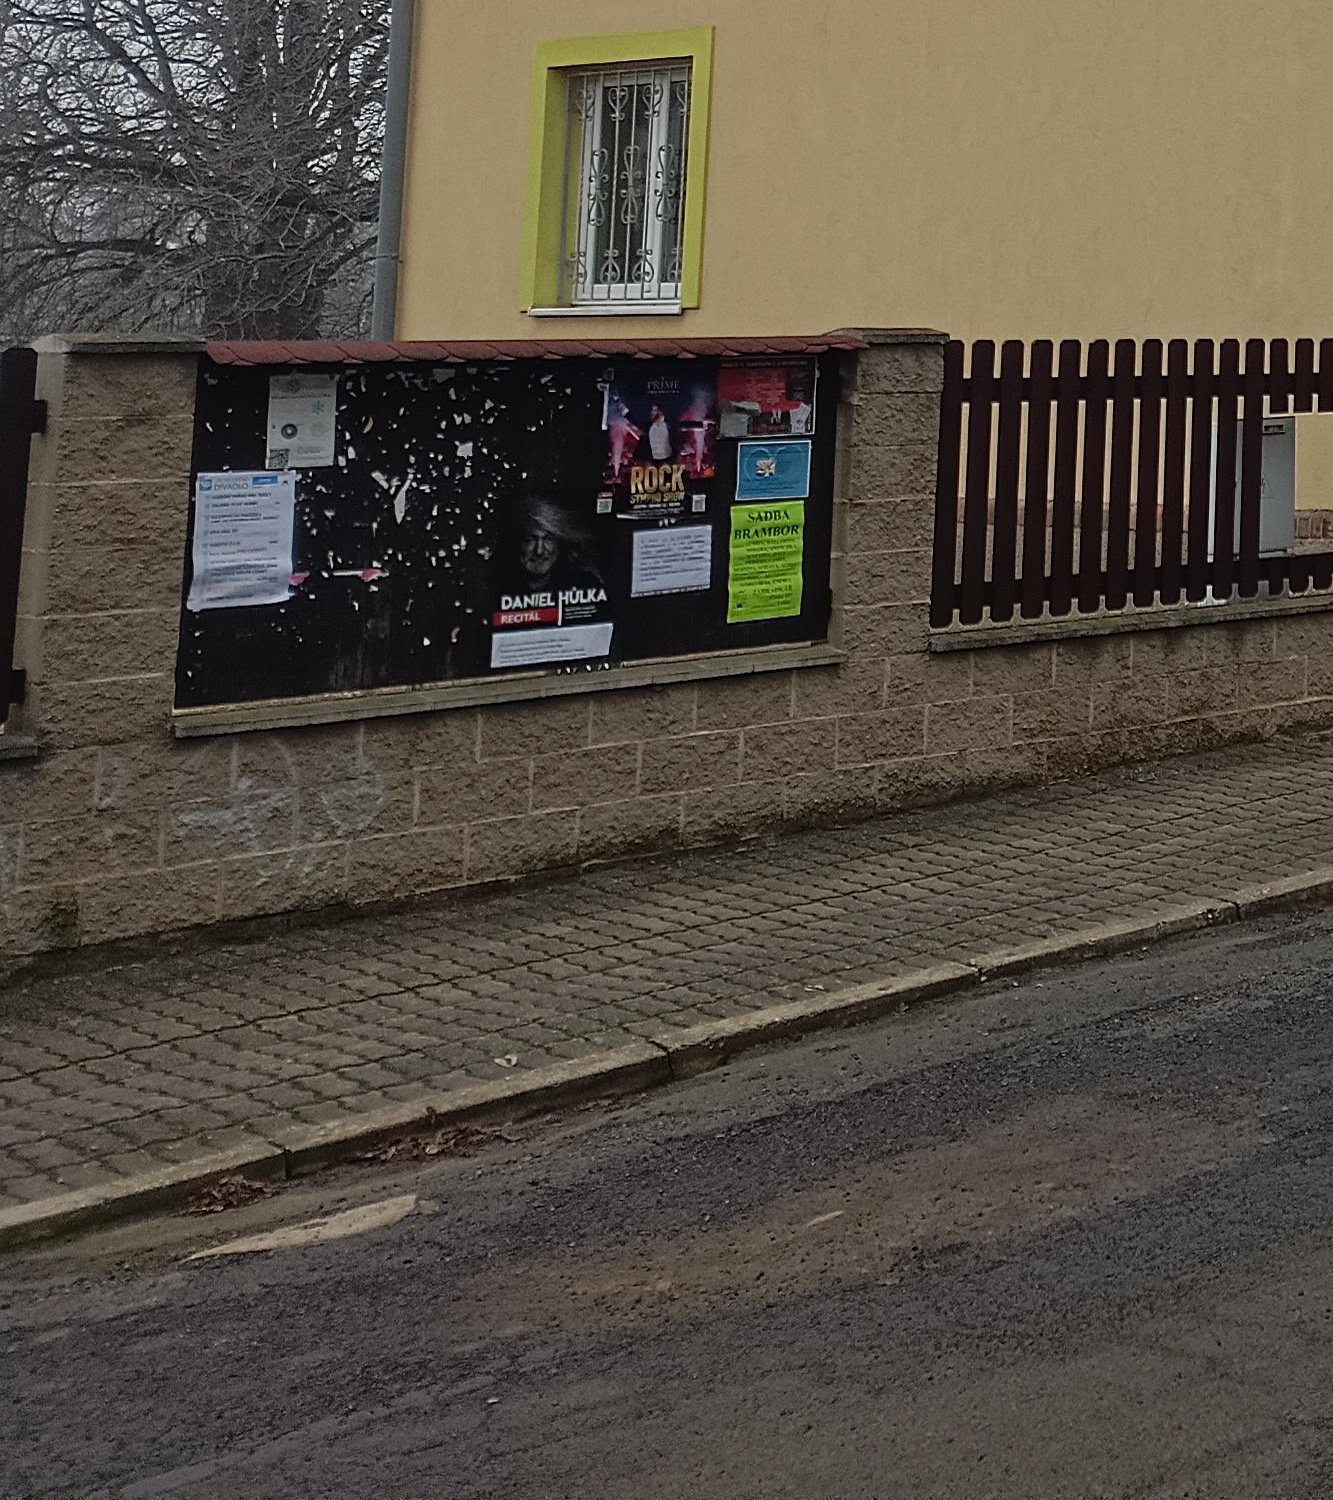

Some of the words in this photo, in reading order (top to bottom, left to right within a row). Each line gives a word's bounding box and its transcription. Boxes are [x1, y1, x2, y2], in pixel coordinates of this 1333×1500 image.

[631, 464, 686, 494] ROCK
[213, 482, 249, 491] DIVADLO
[663, 491, 685, 502] SHOW
[748, 510, 790, 522] SADBA
[734, 524, 800, 540] BRAMBOR
[501, 592, 556, 611] DANIEL
[558, 586, 608, 609] HŮLKA
